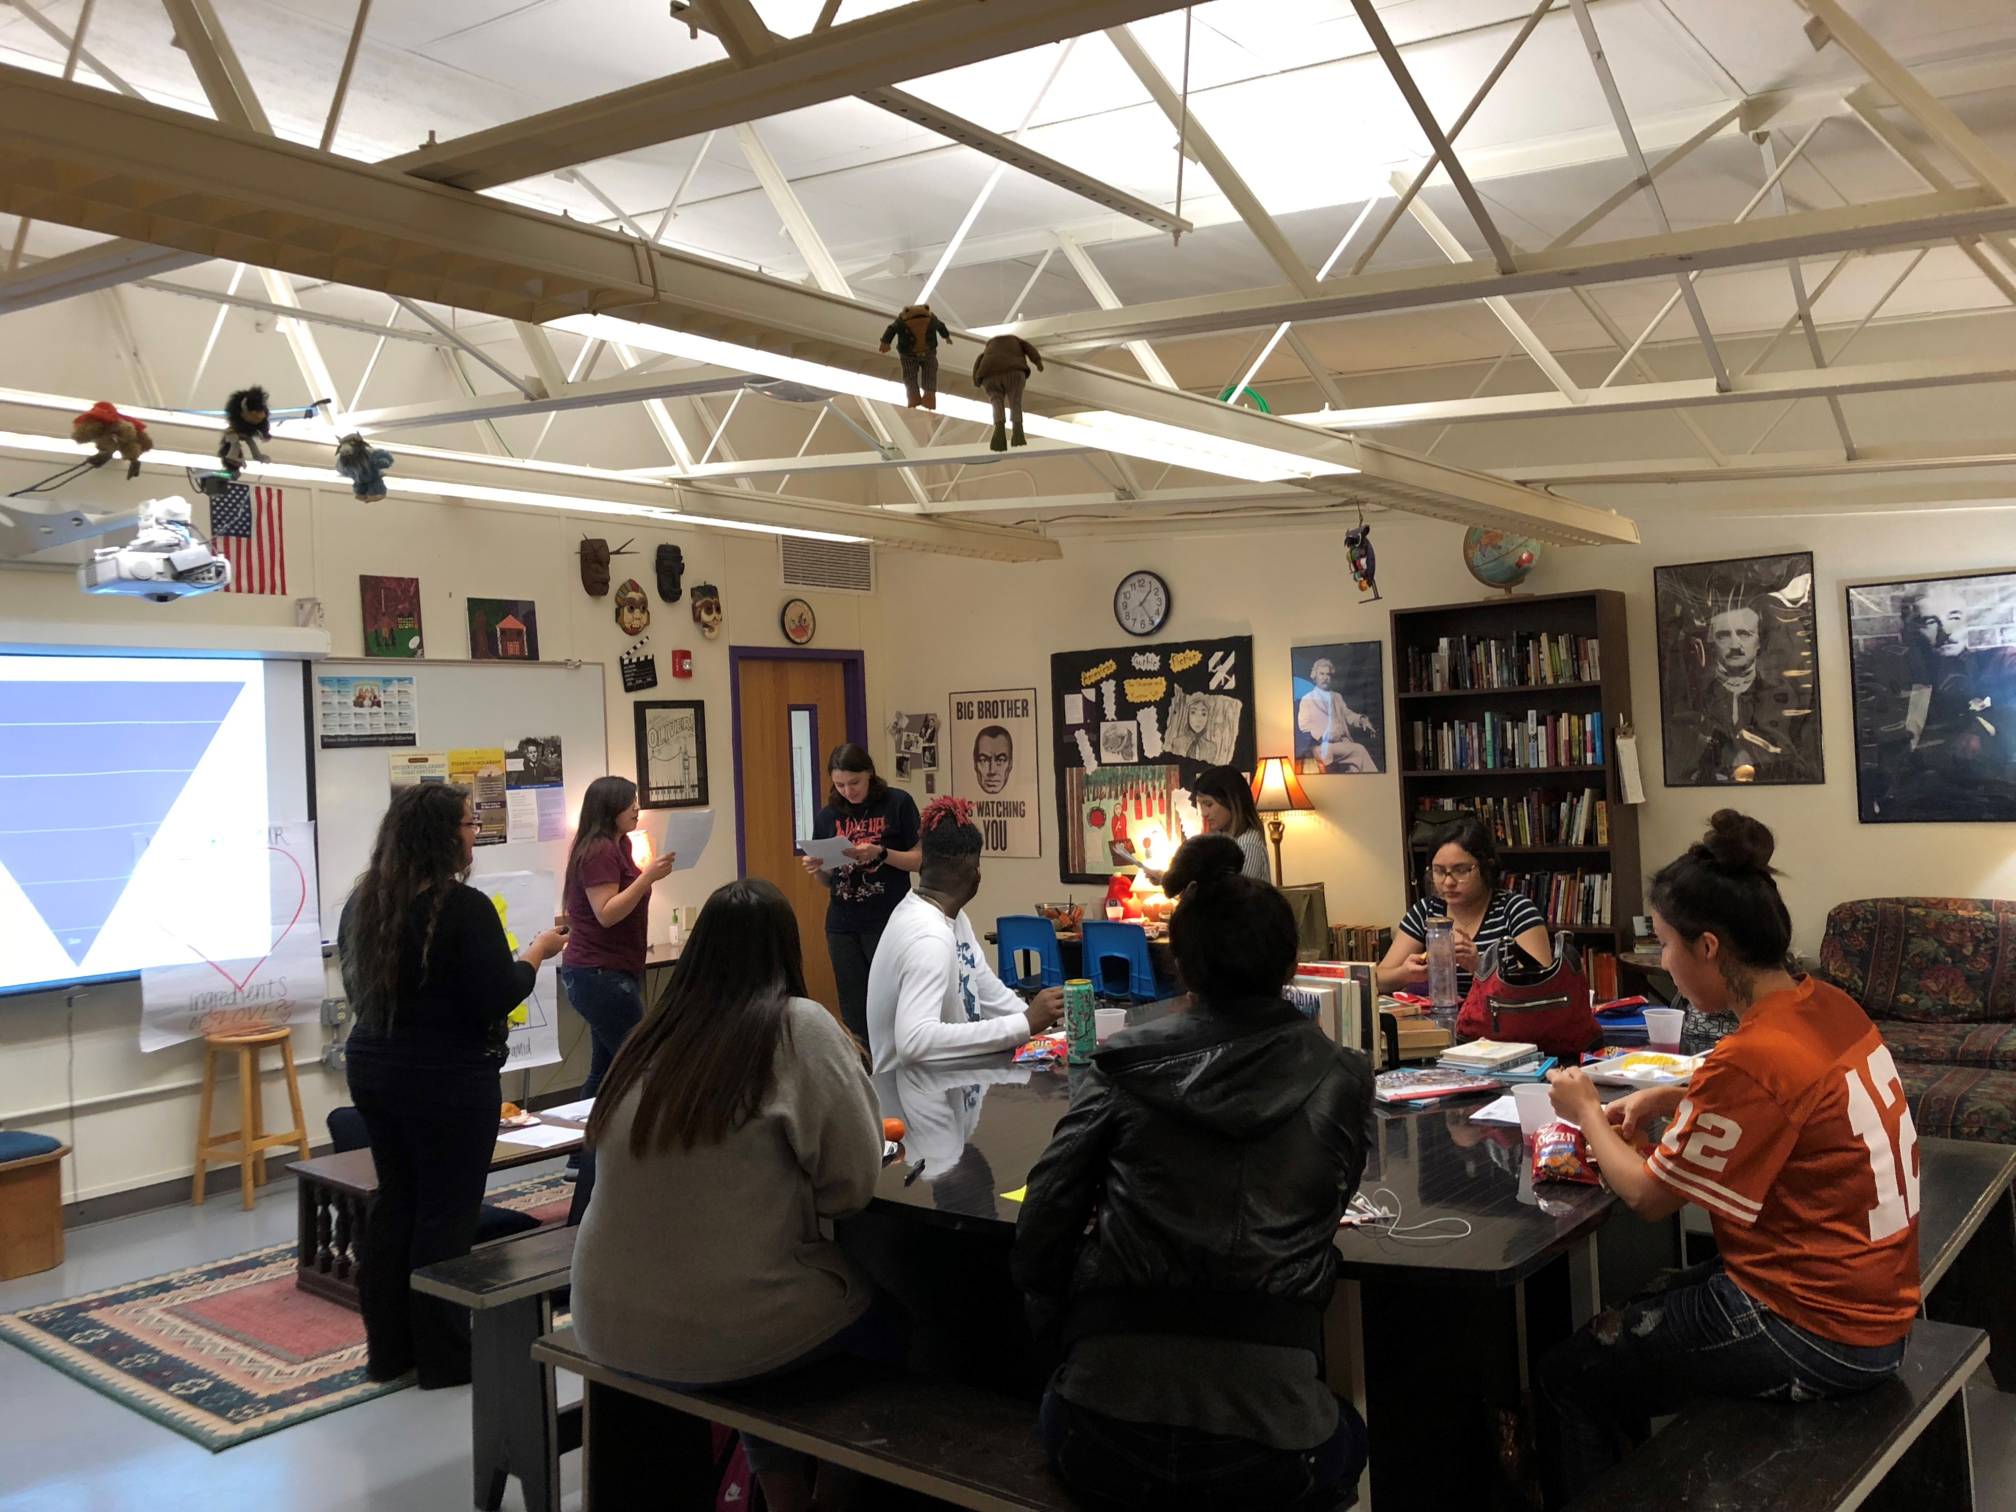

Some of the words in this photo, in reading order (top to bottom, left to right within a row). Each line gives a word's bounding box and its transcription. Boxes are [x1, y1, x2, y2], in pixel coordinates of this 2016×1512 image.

[956, 701, 974, 720] BIG
[977, 699, 1029, 720] BROTHER
[976, 800, 1026, 818] WATCHING
[983, 819, 1008, 851] YOU
[1661, 1099, 1743, 1173] 12
[1844, 1043, 1920, 1242] 12
